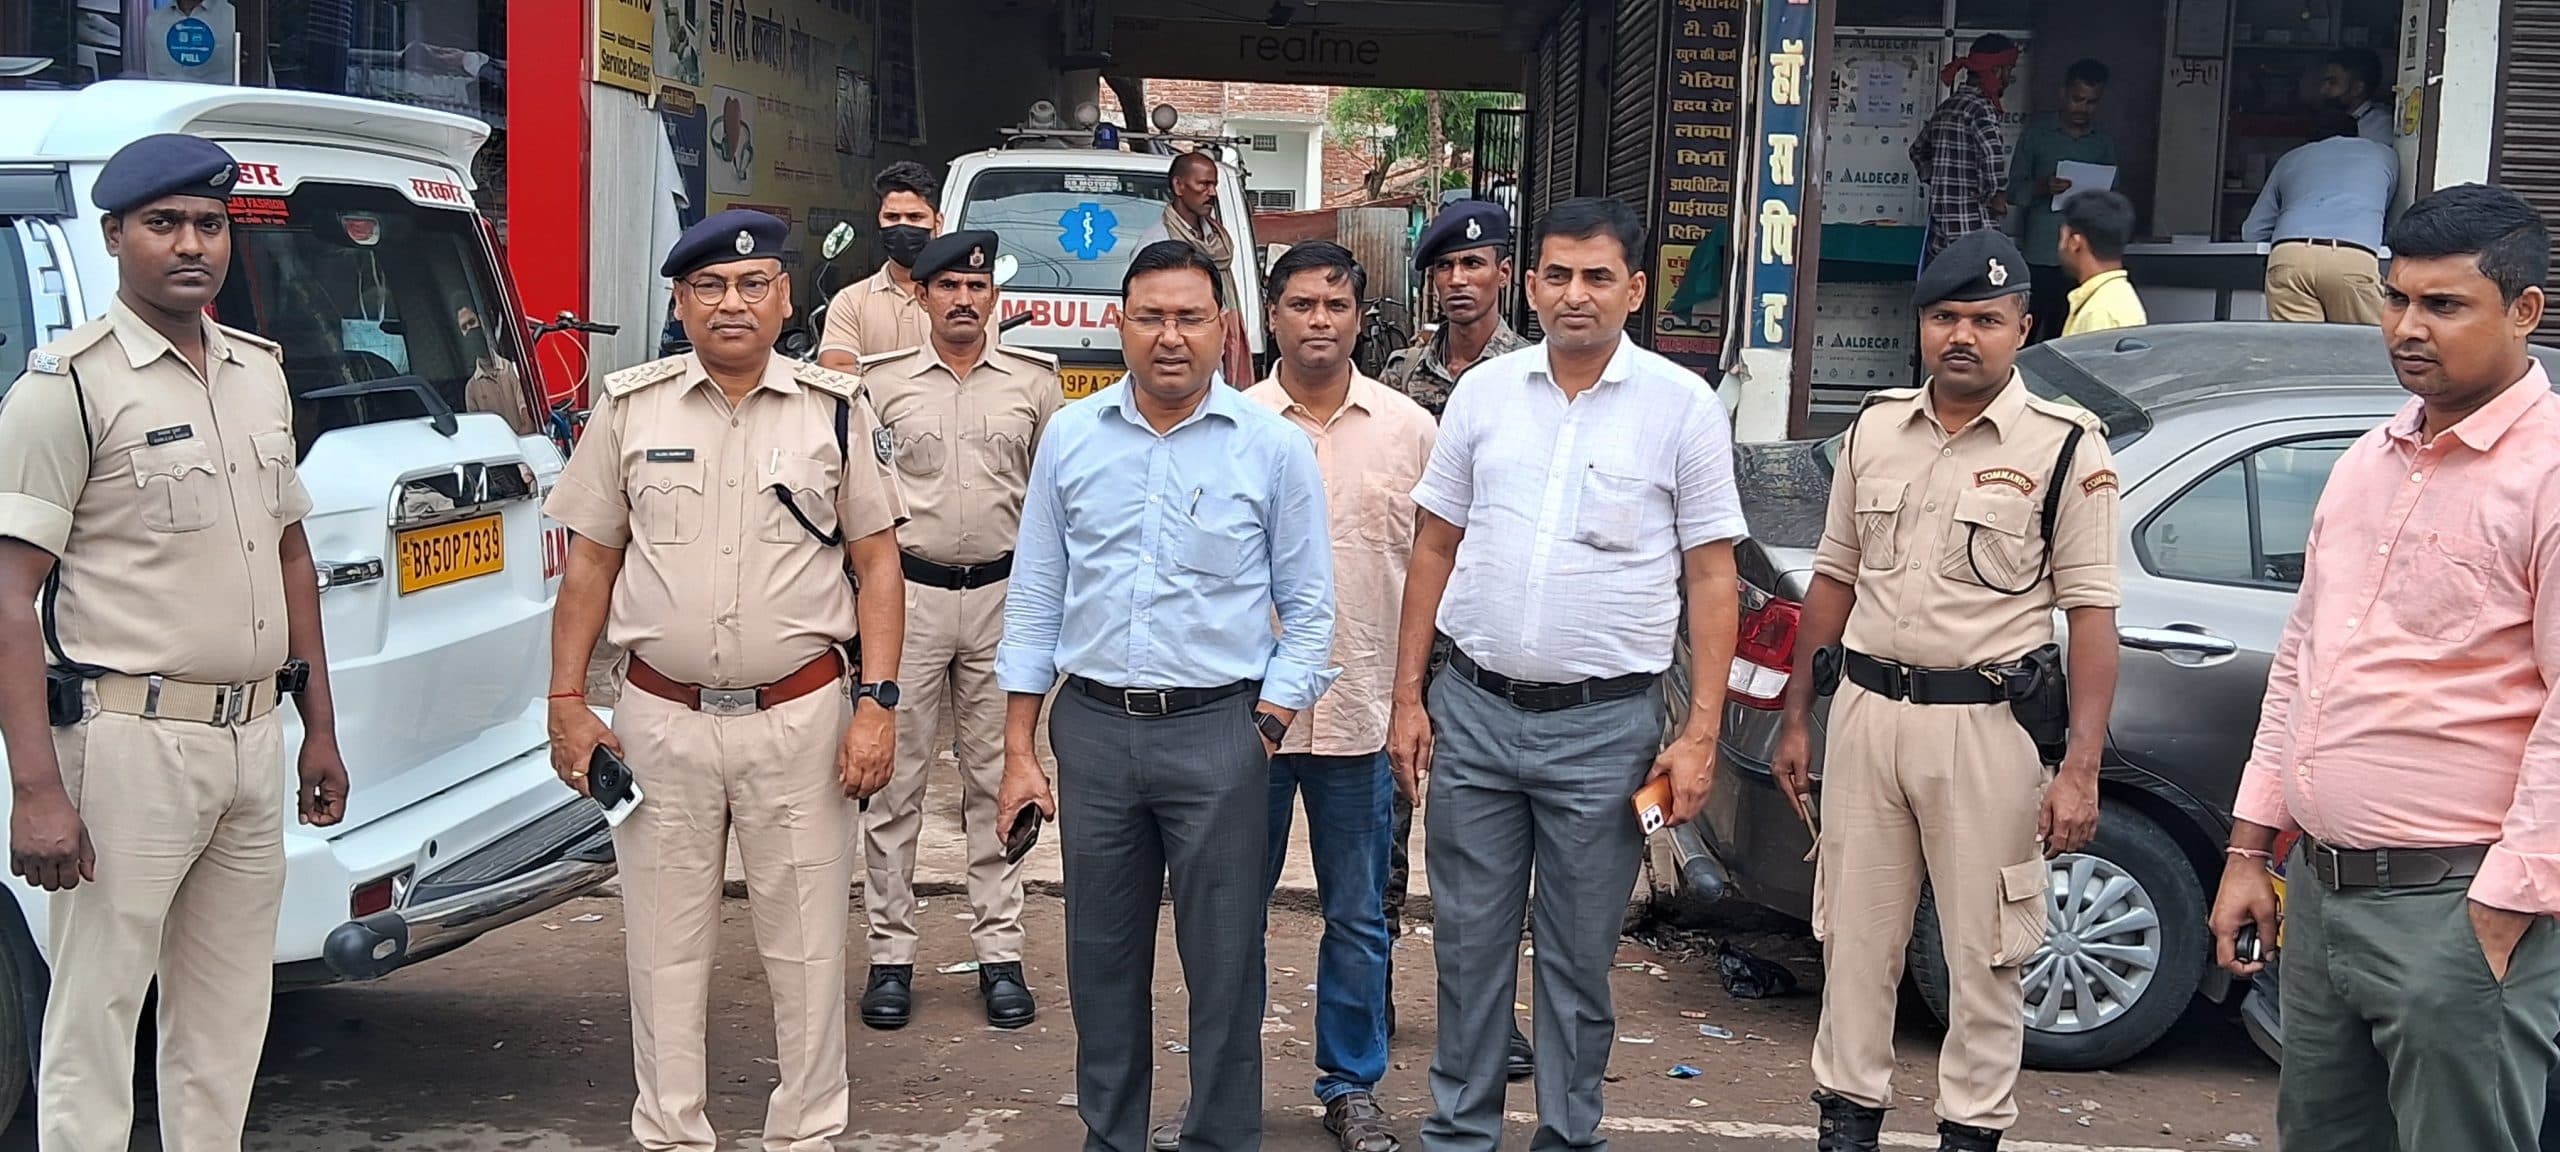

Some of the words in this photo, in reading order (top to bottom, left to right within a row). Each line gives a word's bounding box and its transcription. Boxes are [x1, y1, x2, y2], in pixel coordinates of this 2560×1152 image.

[1239, 34, 1379, 64] realme
[601, 49, 627, 77] Service
[628, 56, 650, 82] Center
[237, 163, 282, 186] हार
[1854, 171, 1909, 184] ALDECOR
[1001, 300, 1119, 328] MBULA
[1845, 336, 1900, 349] ALDECOR
[1979, 471, 2032, 491] COMMANDO
[413, 527, 500, 579] BR50P7939
